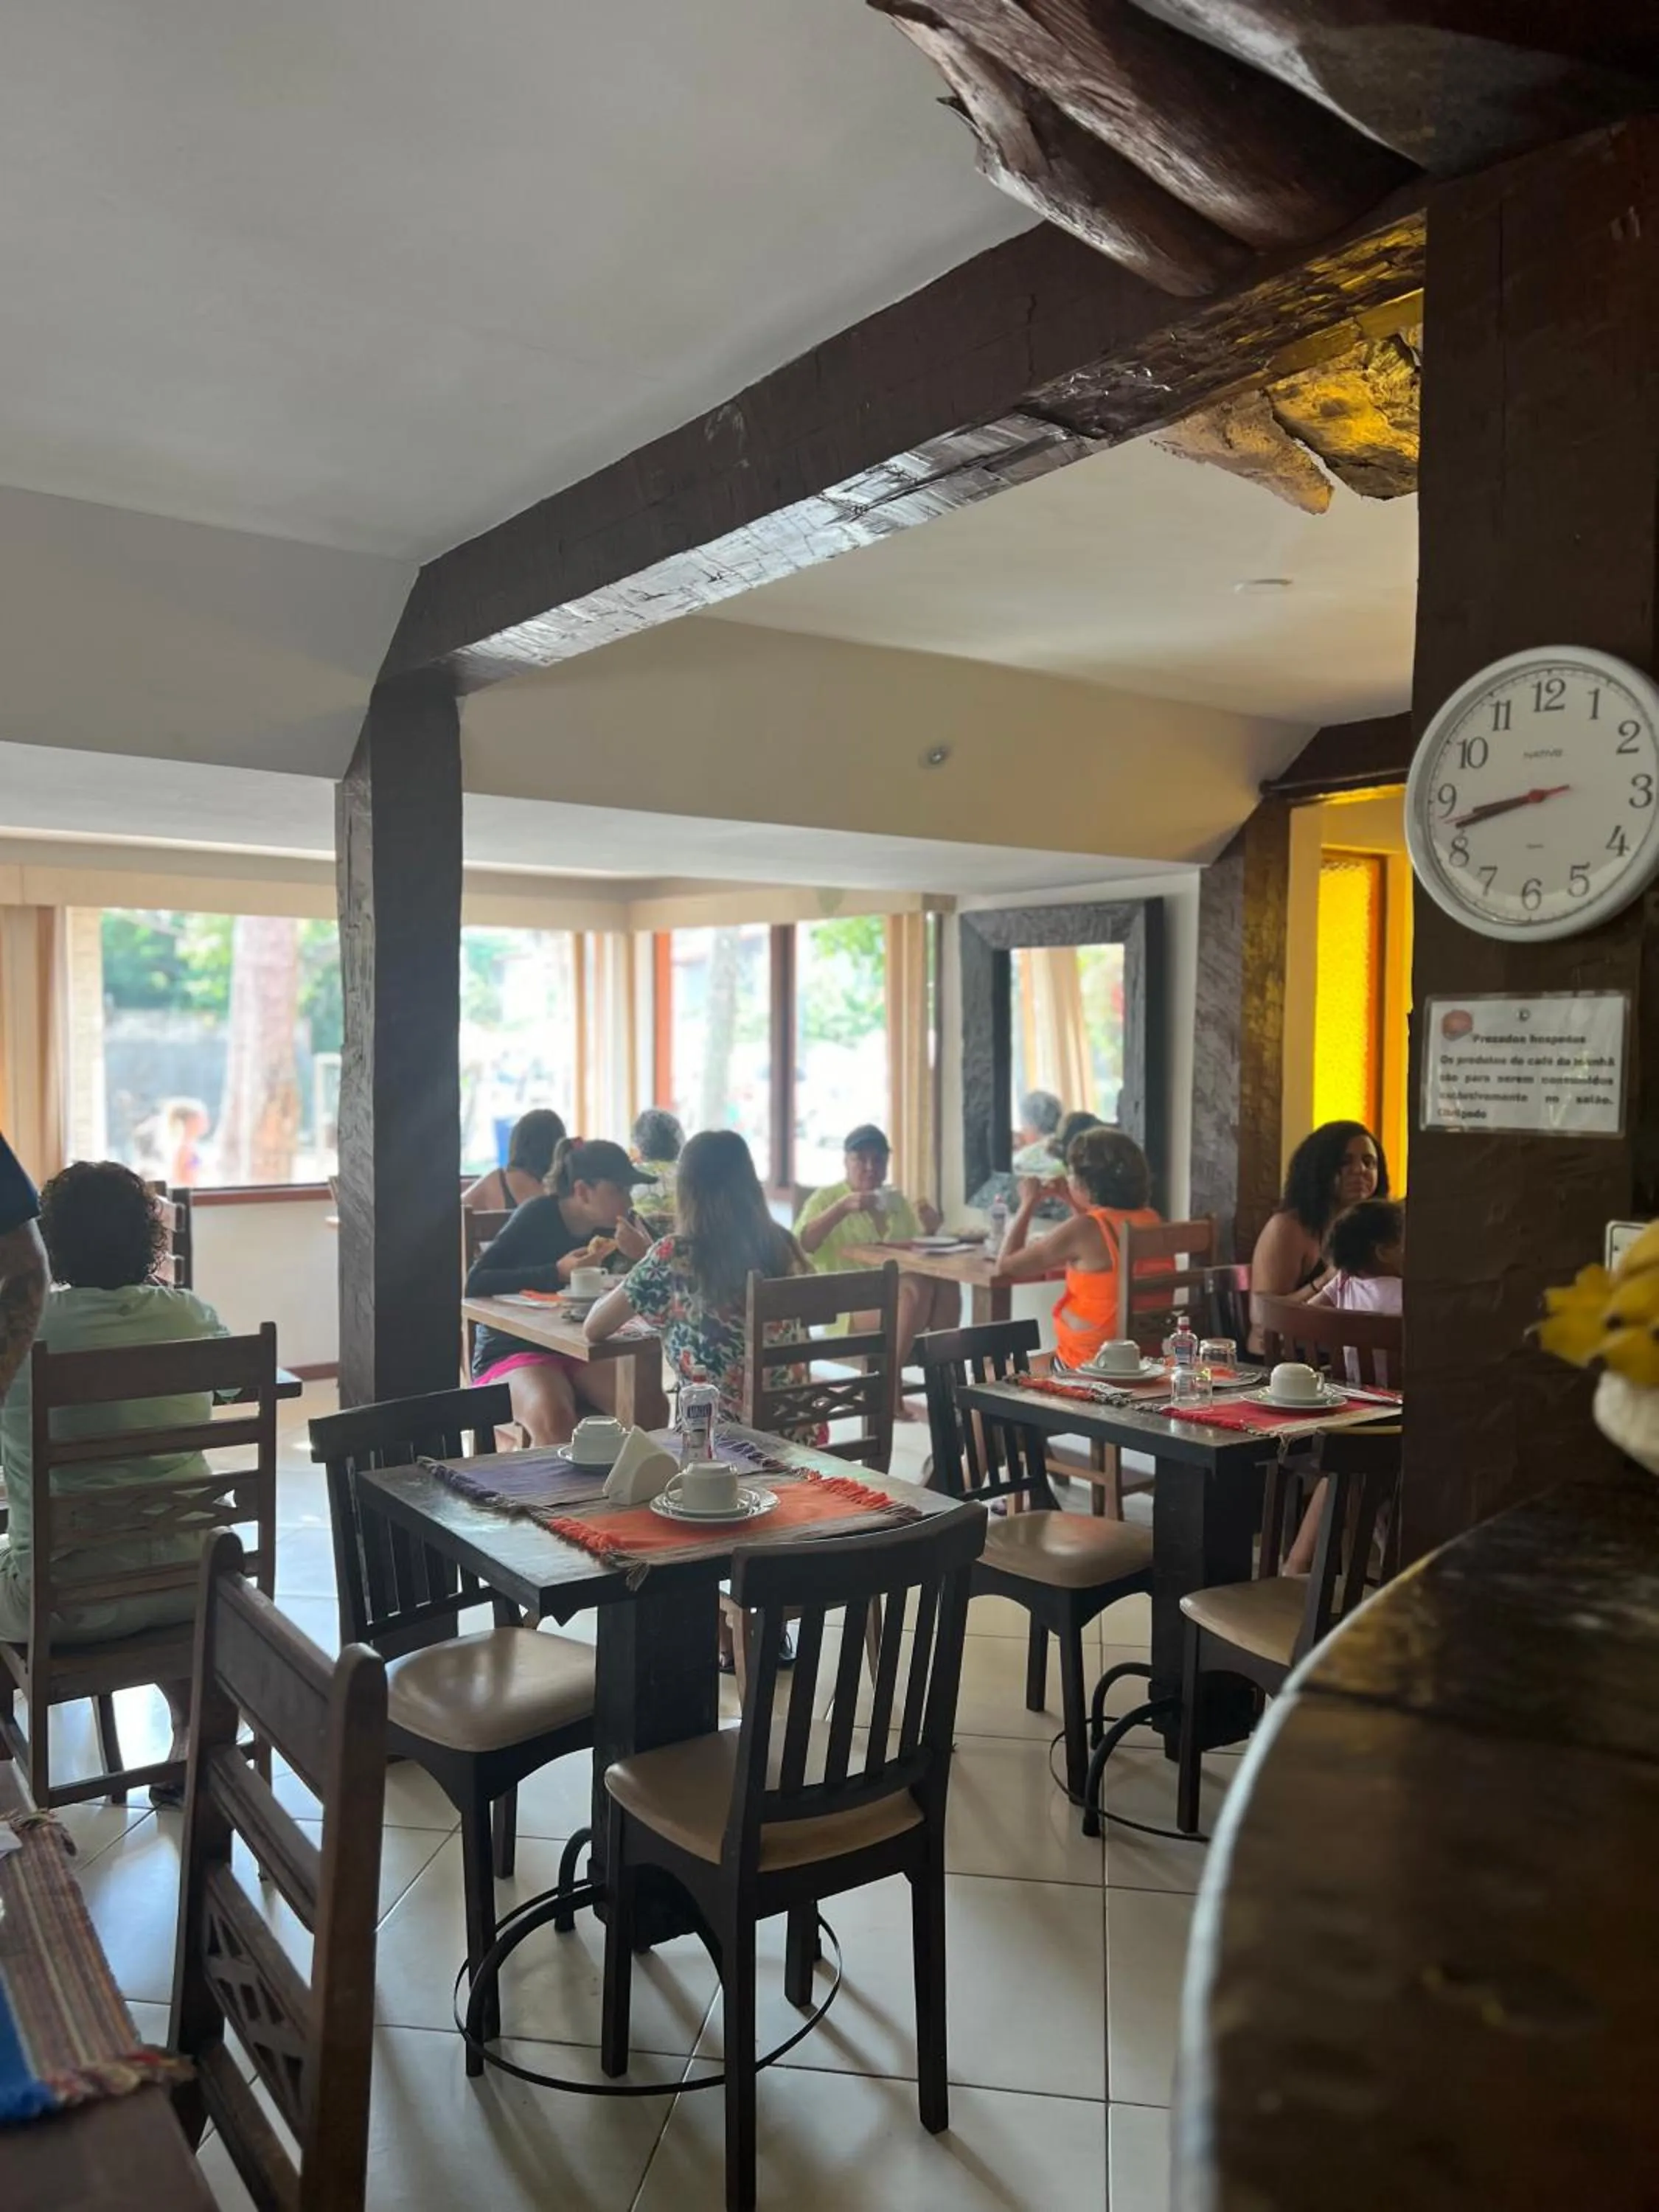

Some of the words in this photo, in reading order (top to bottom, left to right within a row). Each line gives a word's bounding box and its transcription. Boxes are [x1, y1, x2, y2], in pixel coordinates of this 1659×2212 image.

[1532, 678, 1566, 713] 12
[1587, 688, 1600, 720] 1
[1492, 699, 1512, 731] 11
[1457, 737, 1489, 770] 10
[1616, 720, 1641, 755] 2
[1438, 783, 1457, 818] 9
[1628, 773, 1653, 809] 3
[1449, 835, 1470, 868] 8
[1605, 825, 1631, 857] 4
[1477, 866, 1498, 897] 7
[1521, 878, 1543, 911] 6
[1568, 862, 1591, 898] 5
[1545, 1095, 1560, 1104] no
